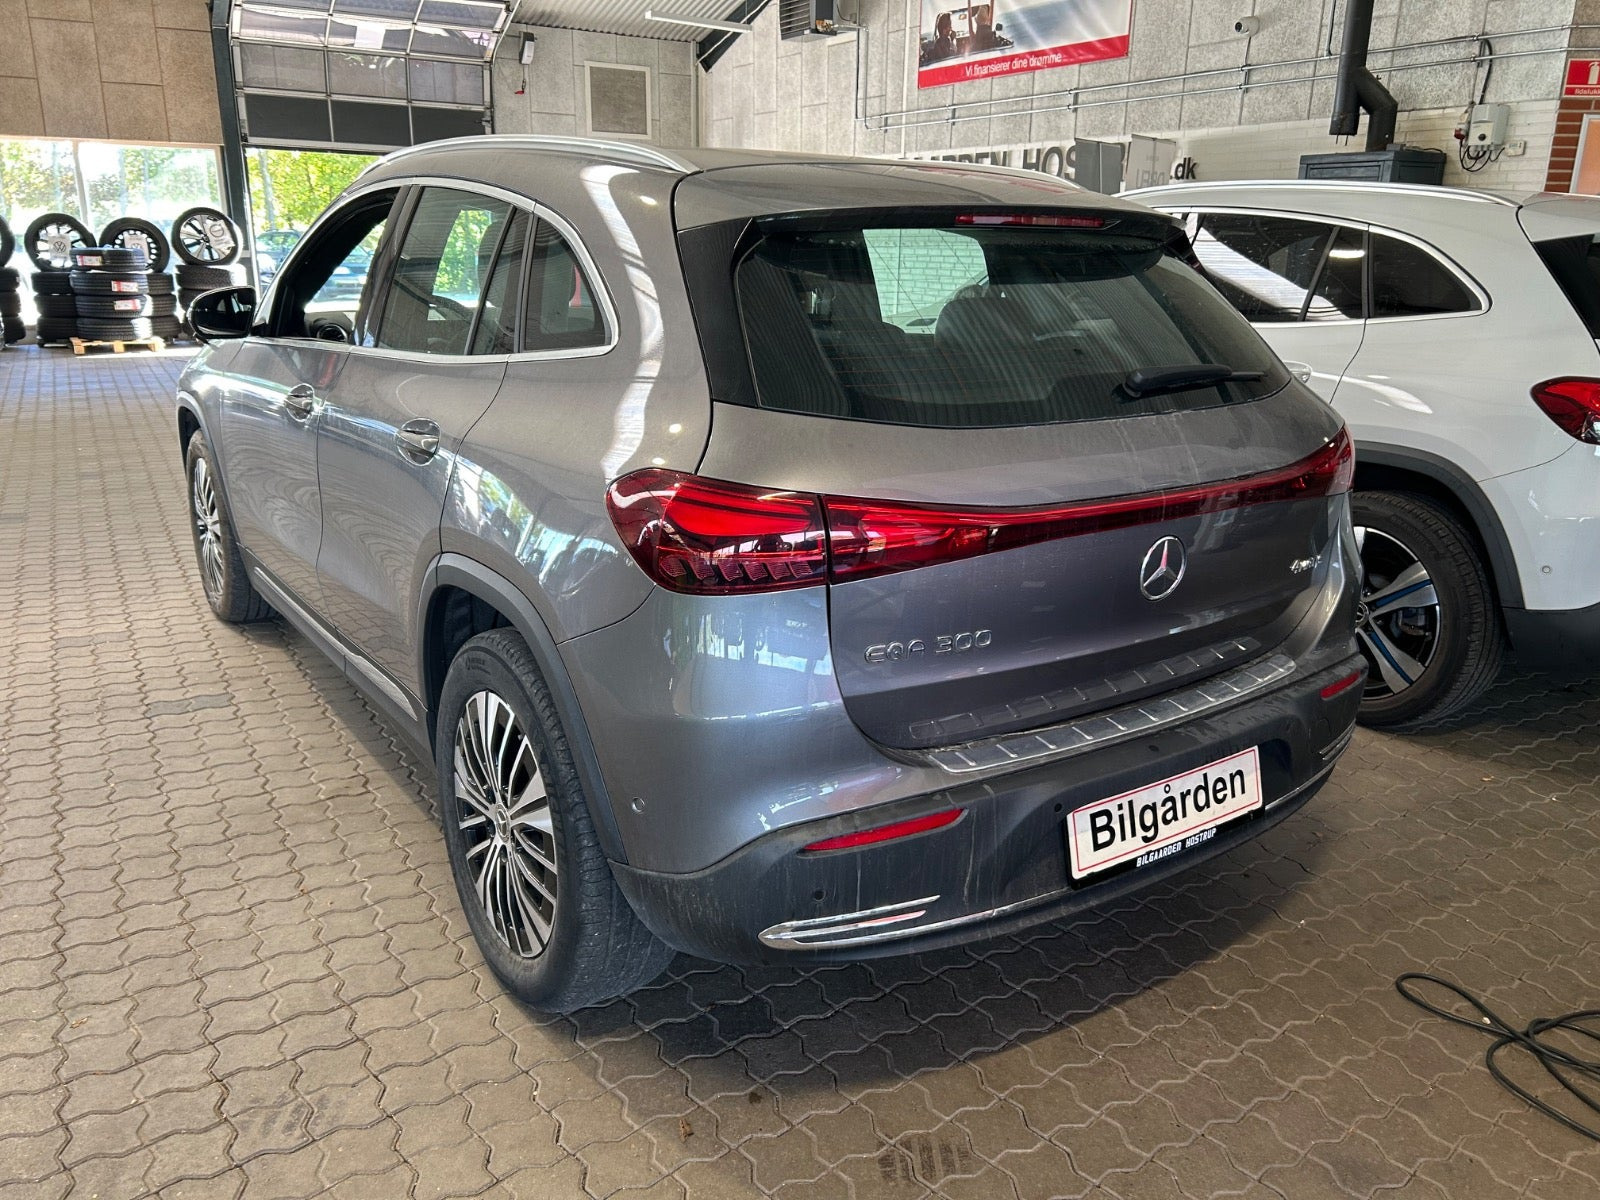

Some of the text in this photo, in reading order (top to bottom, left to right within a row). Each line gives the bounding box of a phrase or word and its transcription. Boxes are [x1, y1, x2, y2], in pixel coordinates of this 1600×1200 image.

[1011, 56, 1028, 70] dine
[864, 629, 993, 664] EQA 300
[1089, 767, 1247, 852] Bilgården
[1136, 827, 1217, 868] BILGAARDEN HOSTRUP
